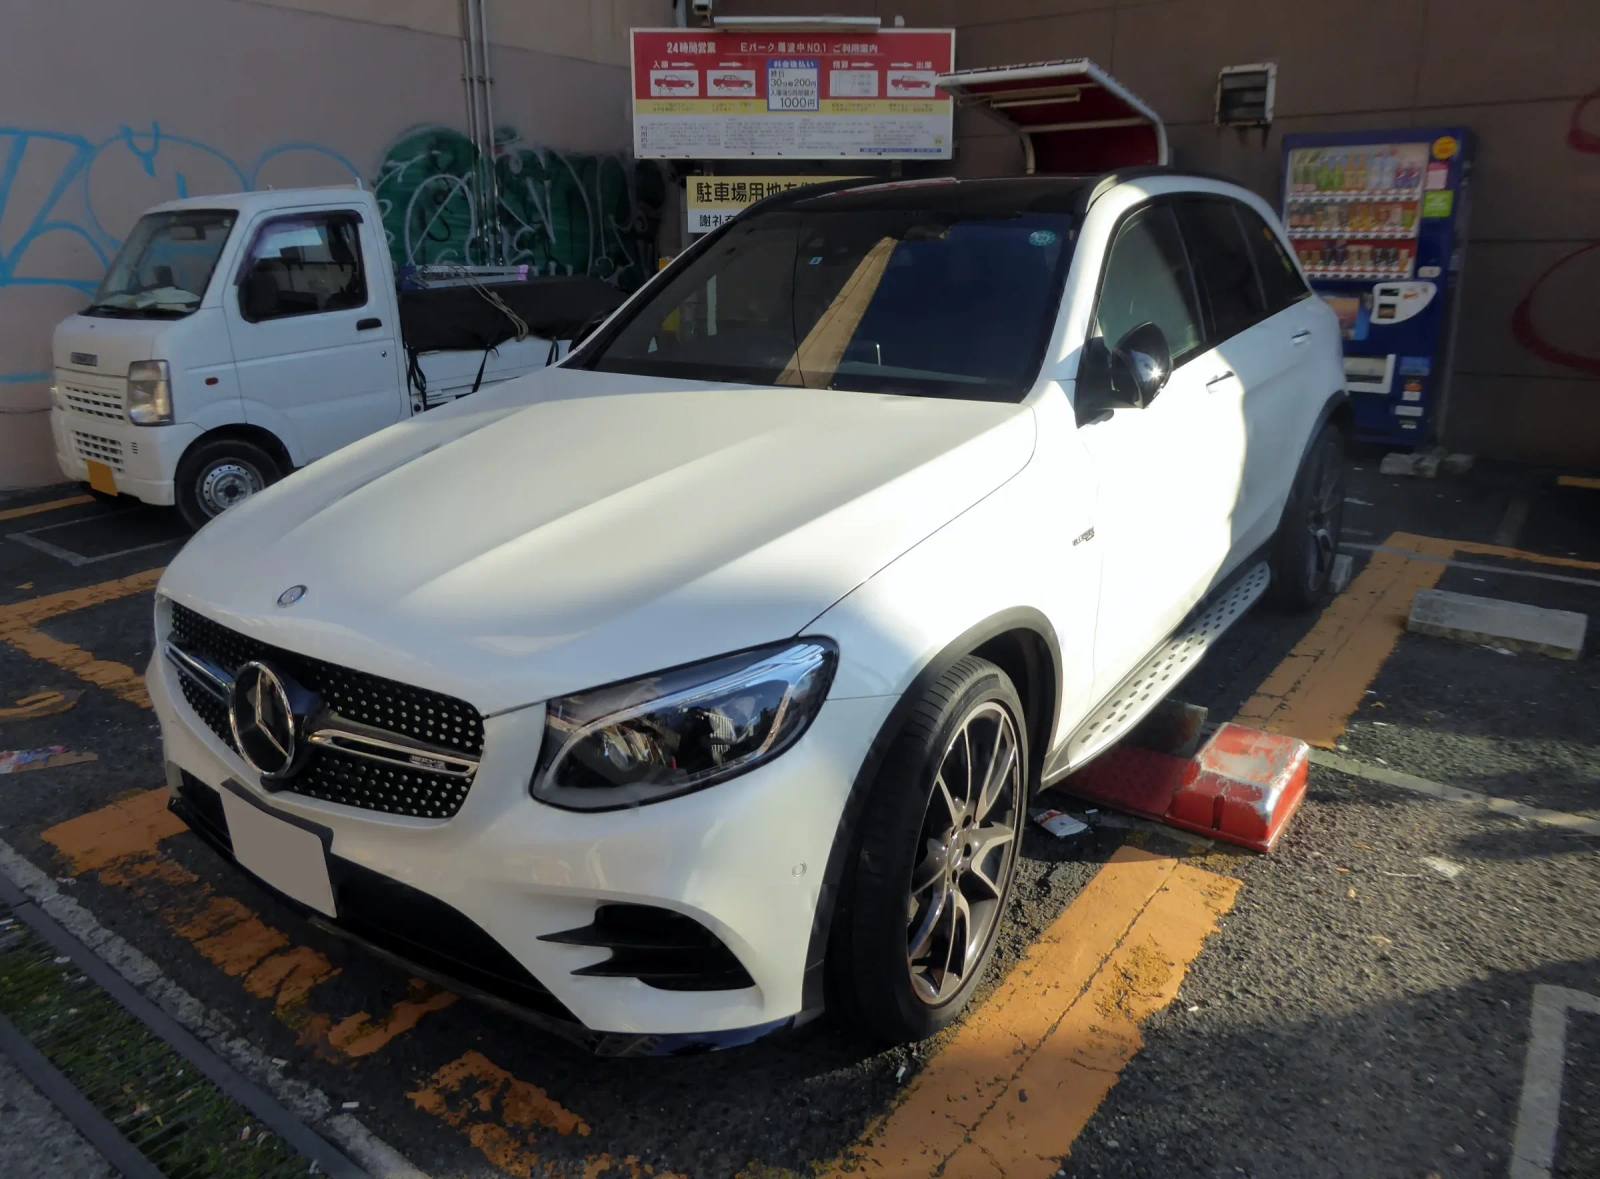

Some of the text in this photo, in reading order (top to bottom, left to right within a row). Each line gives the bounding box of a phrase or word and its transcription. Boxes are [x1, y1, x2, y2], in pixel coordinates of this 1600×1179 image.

[666, 41, 716, 54] 24時間営業
[780, 97, 815, 108] 1000円
